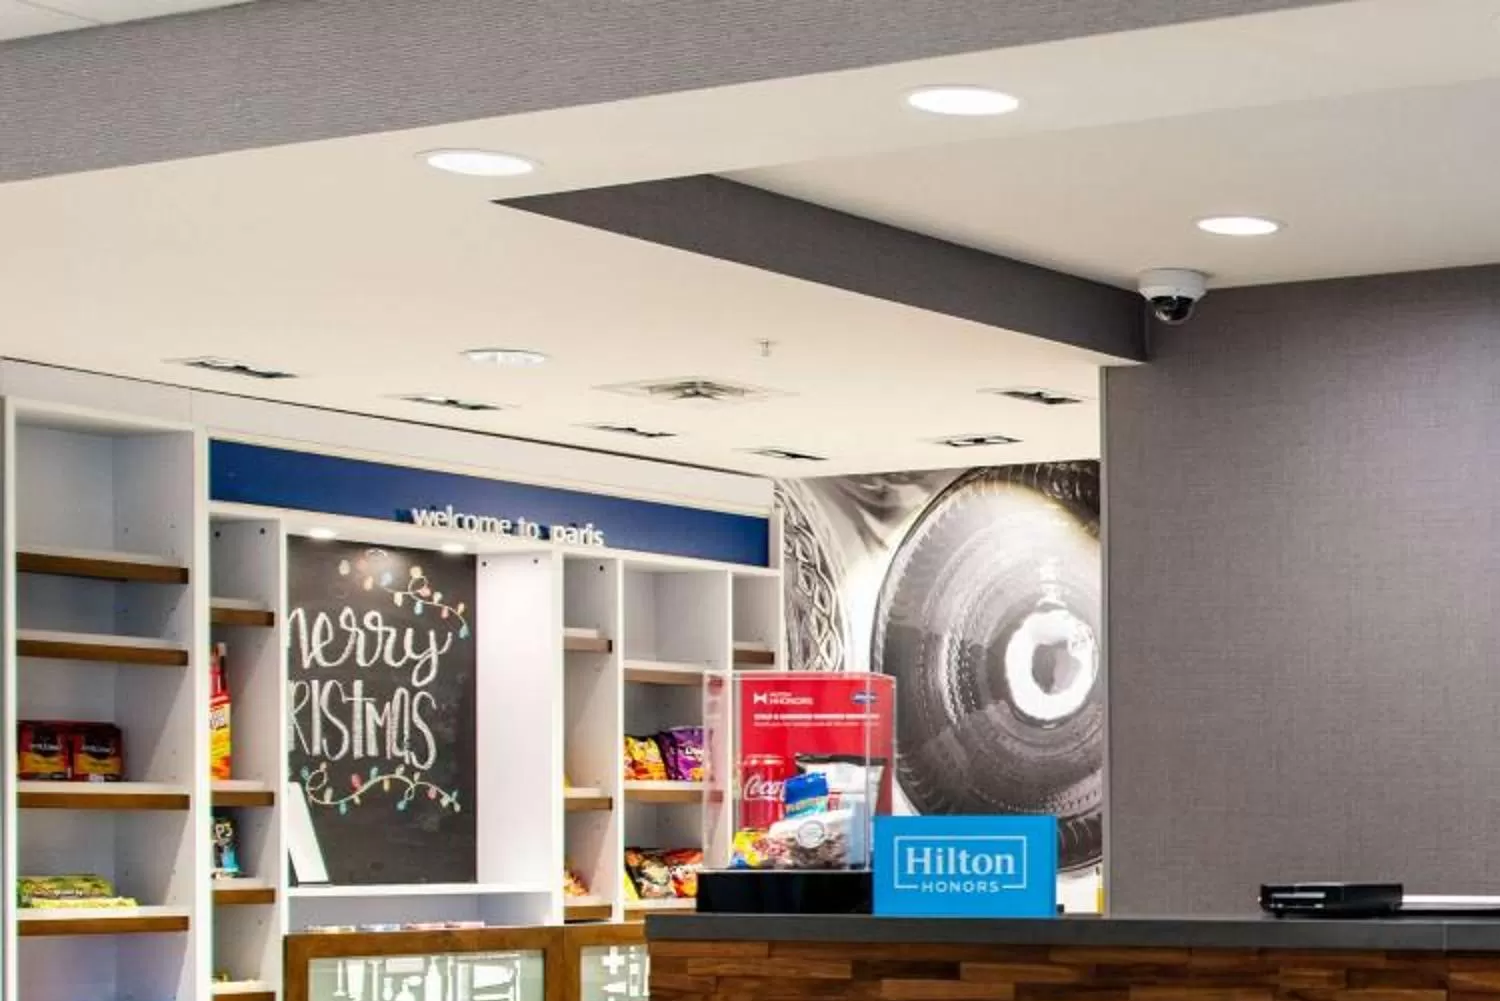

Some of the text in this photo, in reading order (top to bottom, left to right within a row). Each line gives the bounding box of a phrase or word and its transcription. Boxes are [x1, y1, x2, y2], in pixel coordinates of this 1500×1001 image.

[411, 503, 605, 546] welcome to paris
[906, 847, 1016, 876] Hilton
[921, 880, 1000, 893] HONORS
